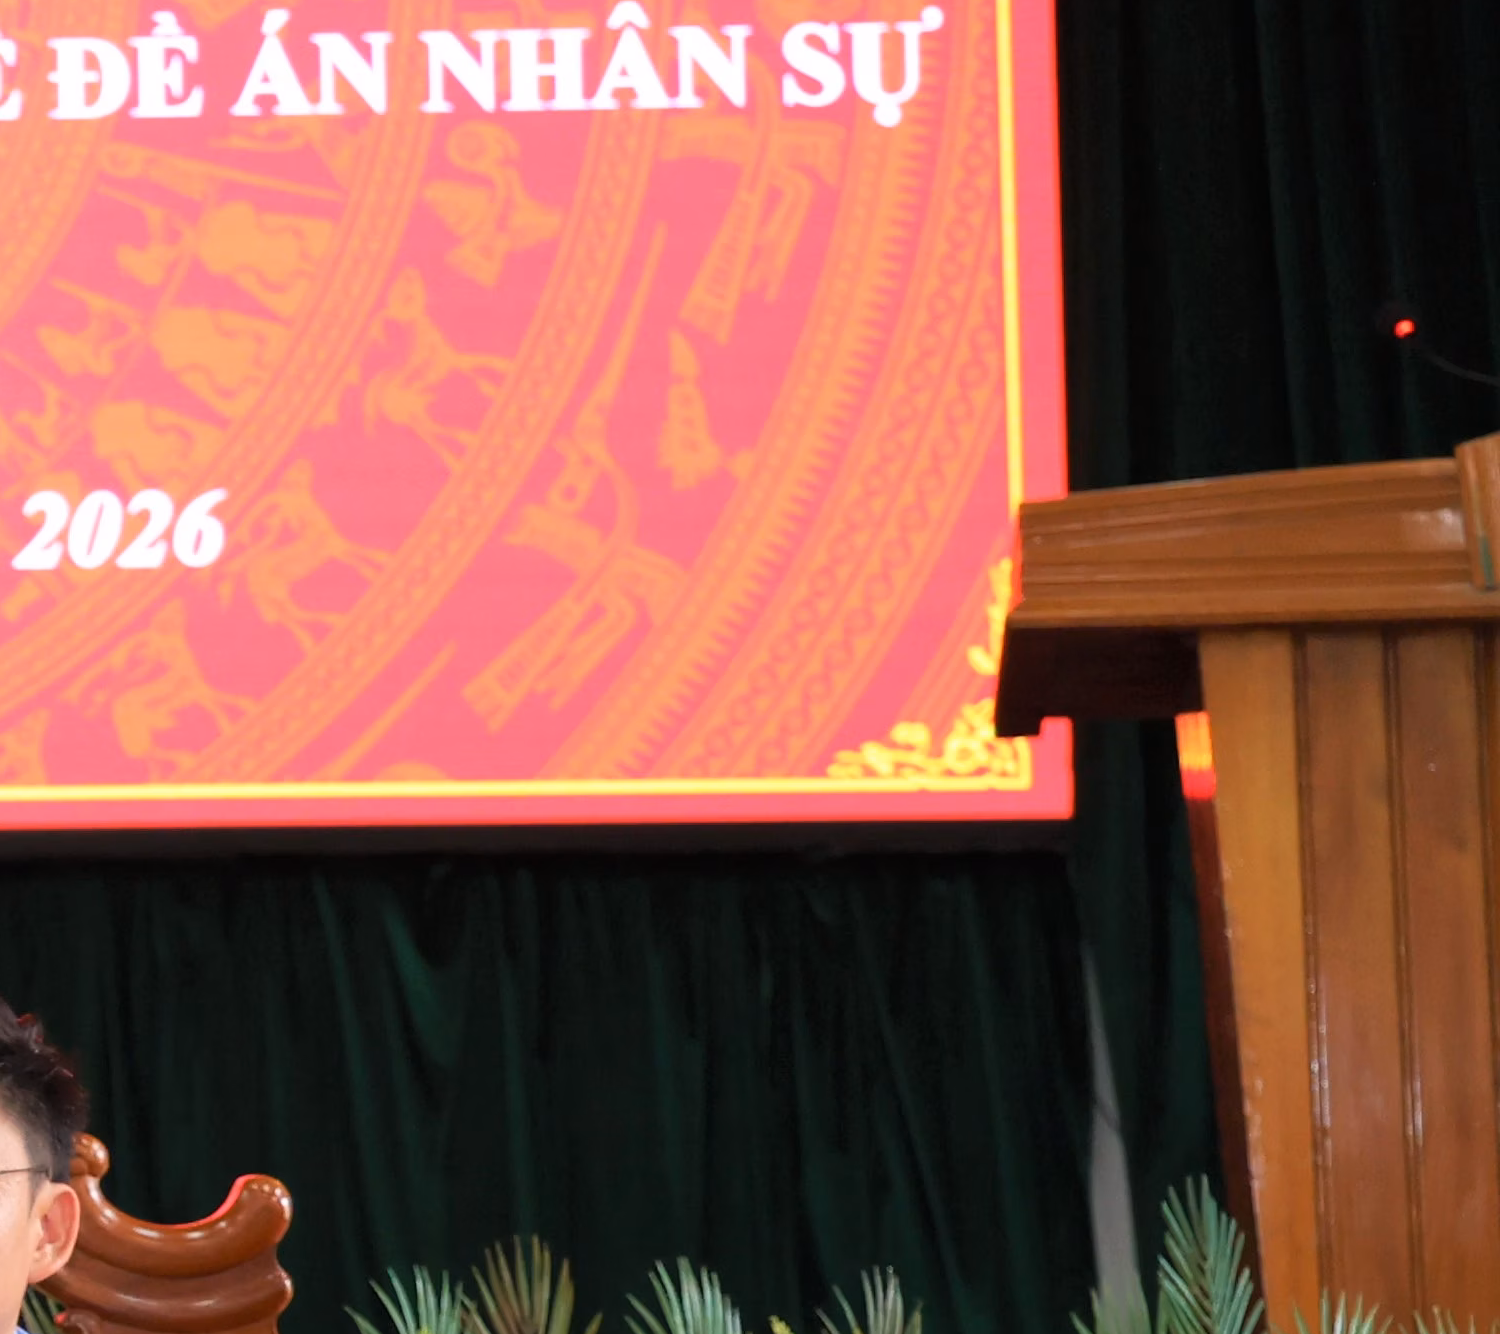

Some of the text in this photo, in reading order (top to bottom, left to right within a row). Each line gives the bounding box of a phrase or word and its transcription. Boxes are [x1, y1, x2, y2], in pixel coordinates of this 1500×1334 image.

[48, 12, 203, 119] ĐỀ
[232, 9, 391, 115] ÁN
[420, 1, 749, 113] NHÂN
[783, 7, 943, 127] SỰ
[12, 489, 226, 570] 2026
